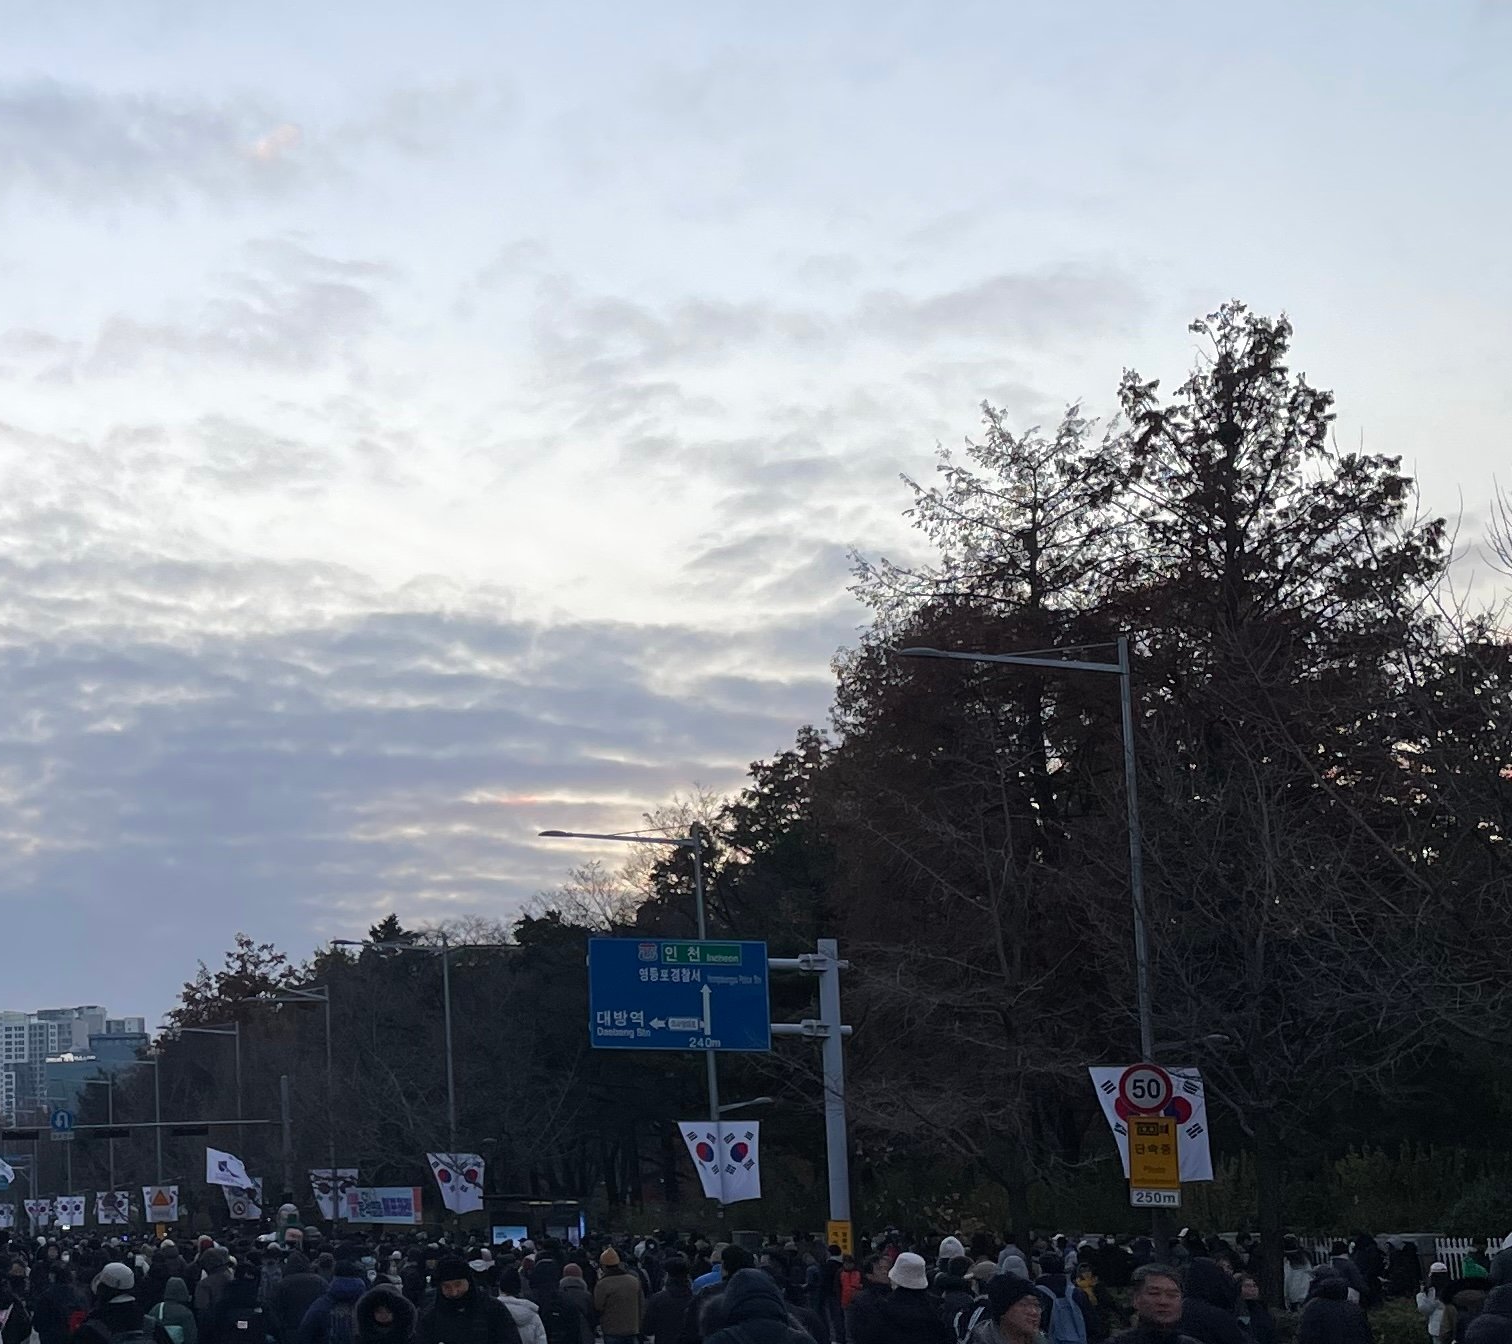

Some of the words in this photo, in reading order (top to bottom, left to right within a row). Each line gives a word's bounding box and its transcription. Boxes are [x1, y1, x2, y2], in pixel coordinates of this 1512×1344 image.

[597, 1010, 644, 1027] 대방역
[688, 1037, 721, 1048] 240m
[1132, 1078, 1161, 1099] 50
[1134, 1143, 1171, 1155] 단속중
[1136, 1192, 1176, 1203] 250m
